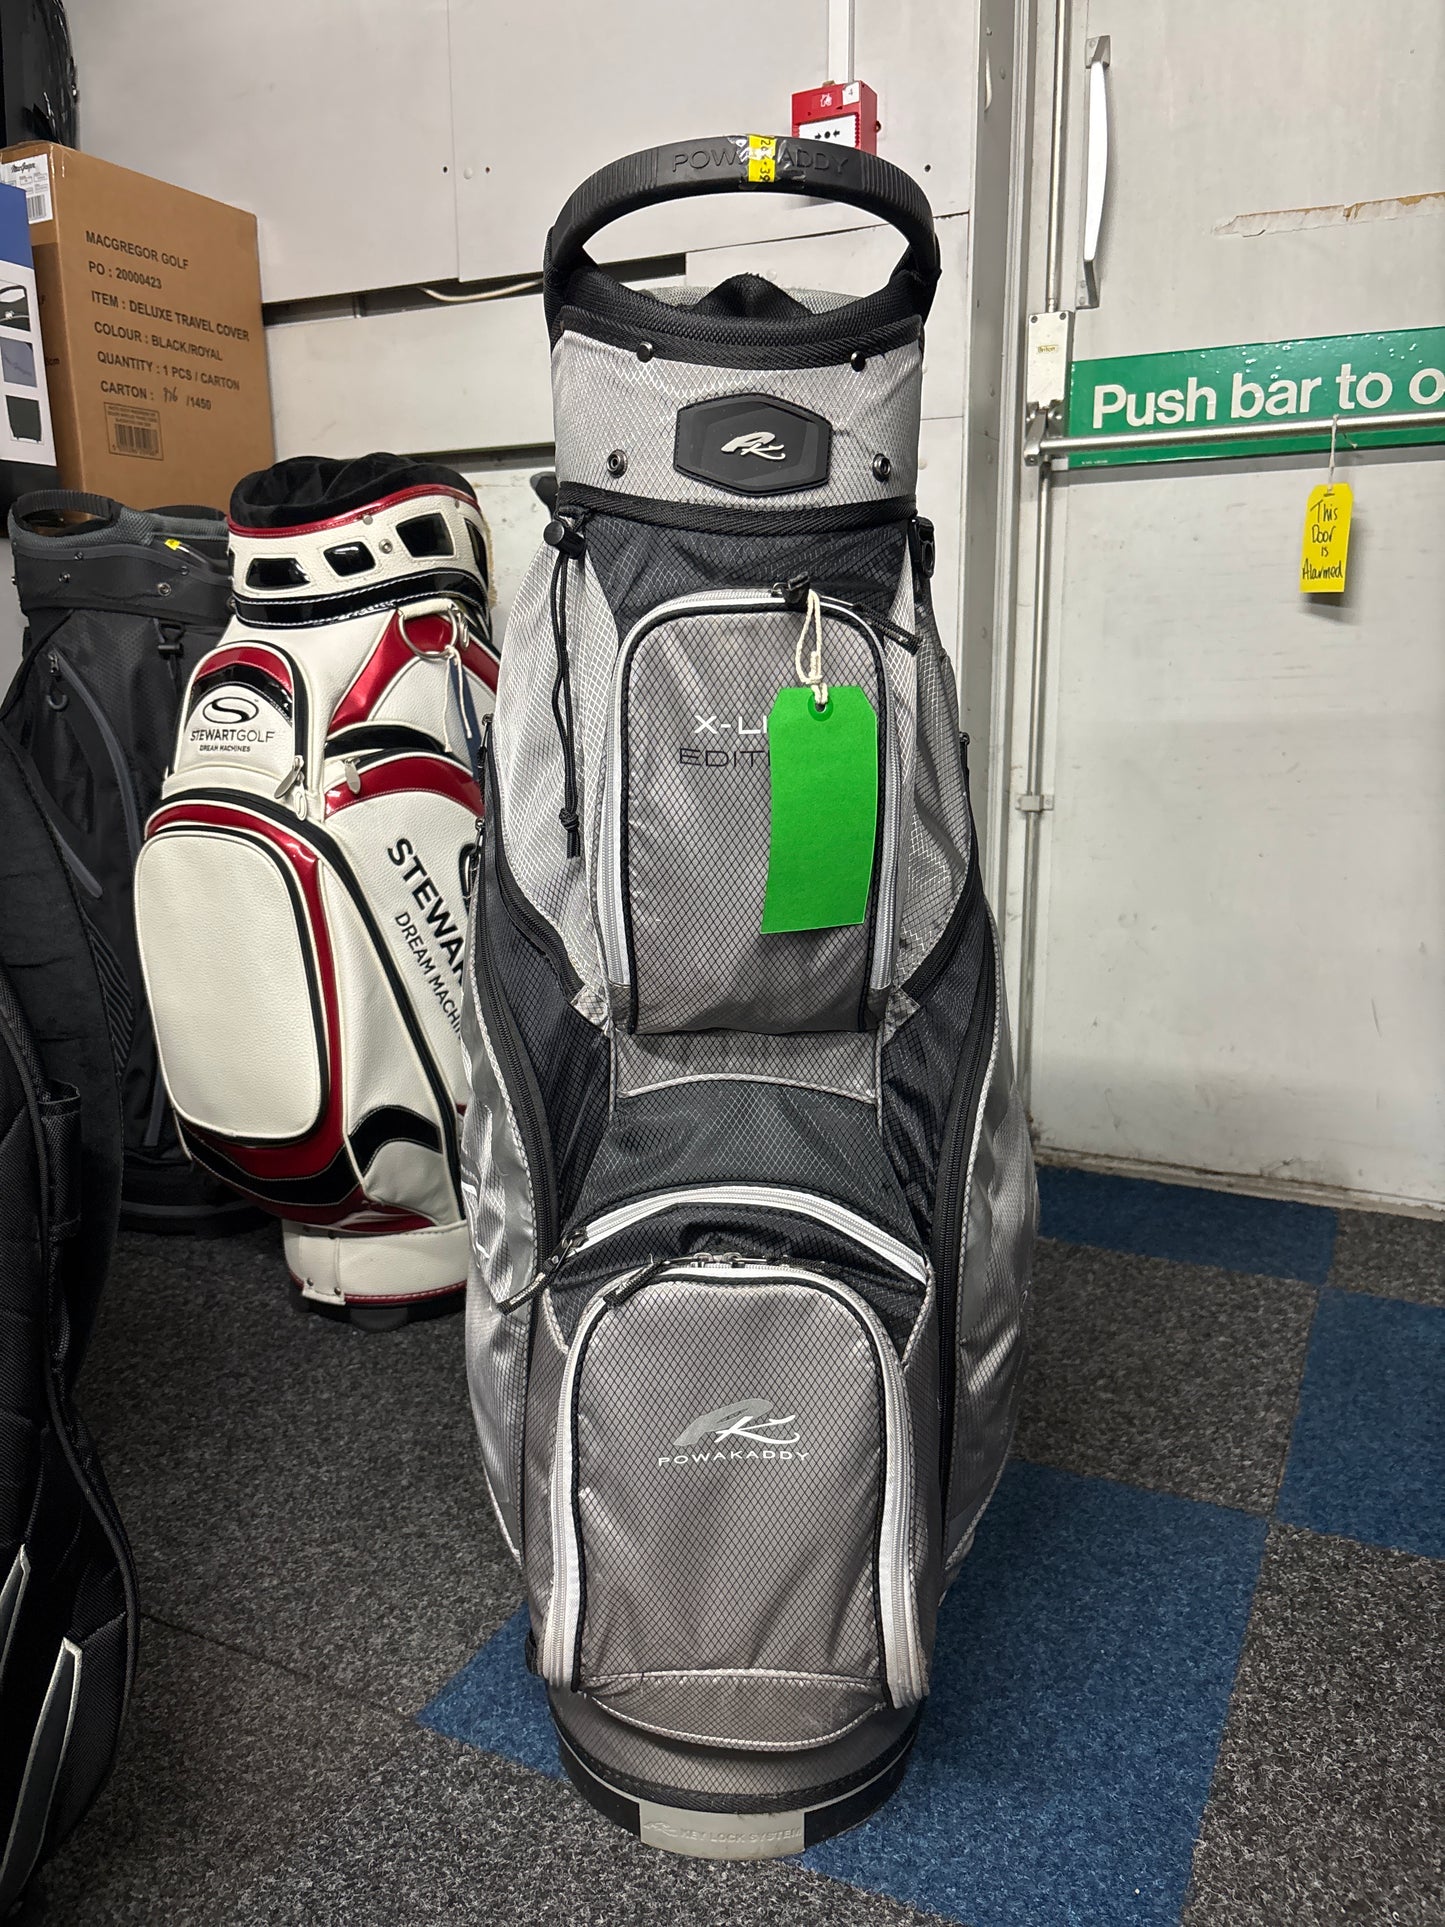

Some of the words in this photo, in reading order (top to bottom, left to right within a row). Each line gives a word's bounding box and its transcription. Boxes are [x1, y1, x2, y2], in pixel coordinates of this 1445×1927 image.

[671, 145, 848, 174] POWADDY
[85, 230, 159, 262] MACGREGOR
[161, 253, 189, 270] GOLF
[88, 260, 105, 276] PO
[115, 267, 162, 290] 20000423
[91, 290, 119, 308] ITEM
[129, 299, 173, 322] DELUXE
[174, 311, 214, 333] TRAVEL
[216, 322, 250, 342] COVER
[94, 321, 142, 343] COLOUR
[151, 334, 223, 362] BLACK/ROYAL
[97, 350, 153, 372] QUANTITY
[162, 364, 168, 376] 1
[171, 366, 193, 381] PCS
[200, 371, 240, 391] CARTON
[101, 380, 147, 399] CARTON
[1092, 376, 1217, 429] Push
[1230, 372, 1322, 419] bar
[1335, 363, 1393, 410] to
[1310, 499, 1338, 523] This
[1311, 524, 1336, 543] Door
[1302, 558, 1343, 580] Alarmed
[694, 715, 768, 734] X-LI
[199, 744, 219, 752] DREAM
[679, 748, 770, 768] EDITI
[395, 911, 436, 976] DREAM
[658, 1450, 809, 1467] POWAKADDY
